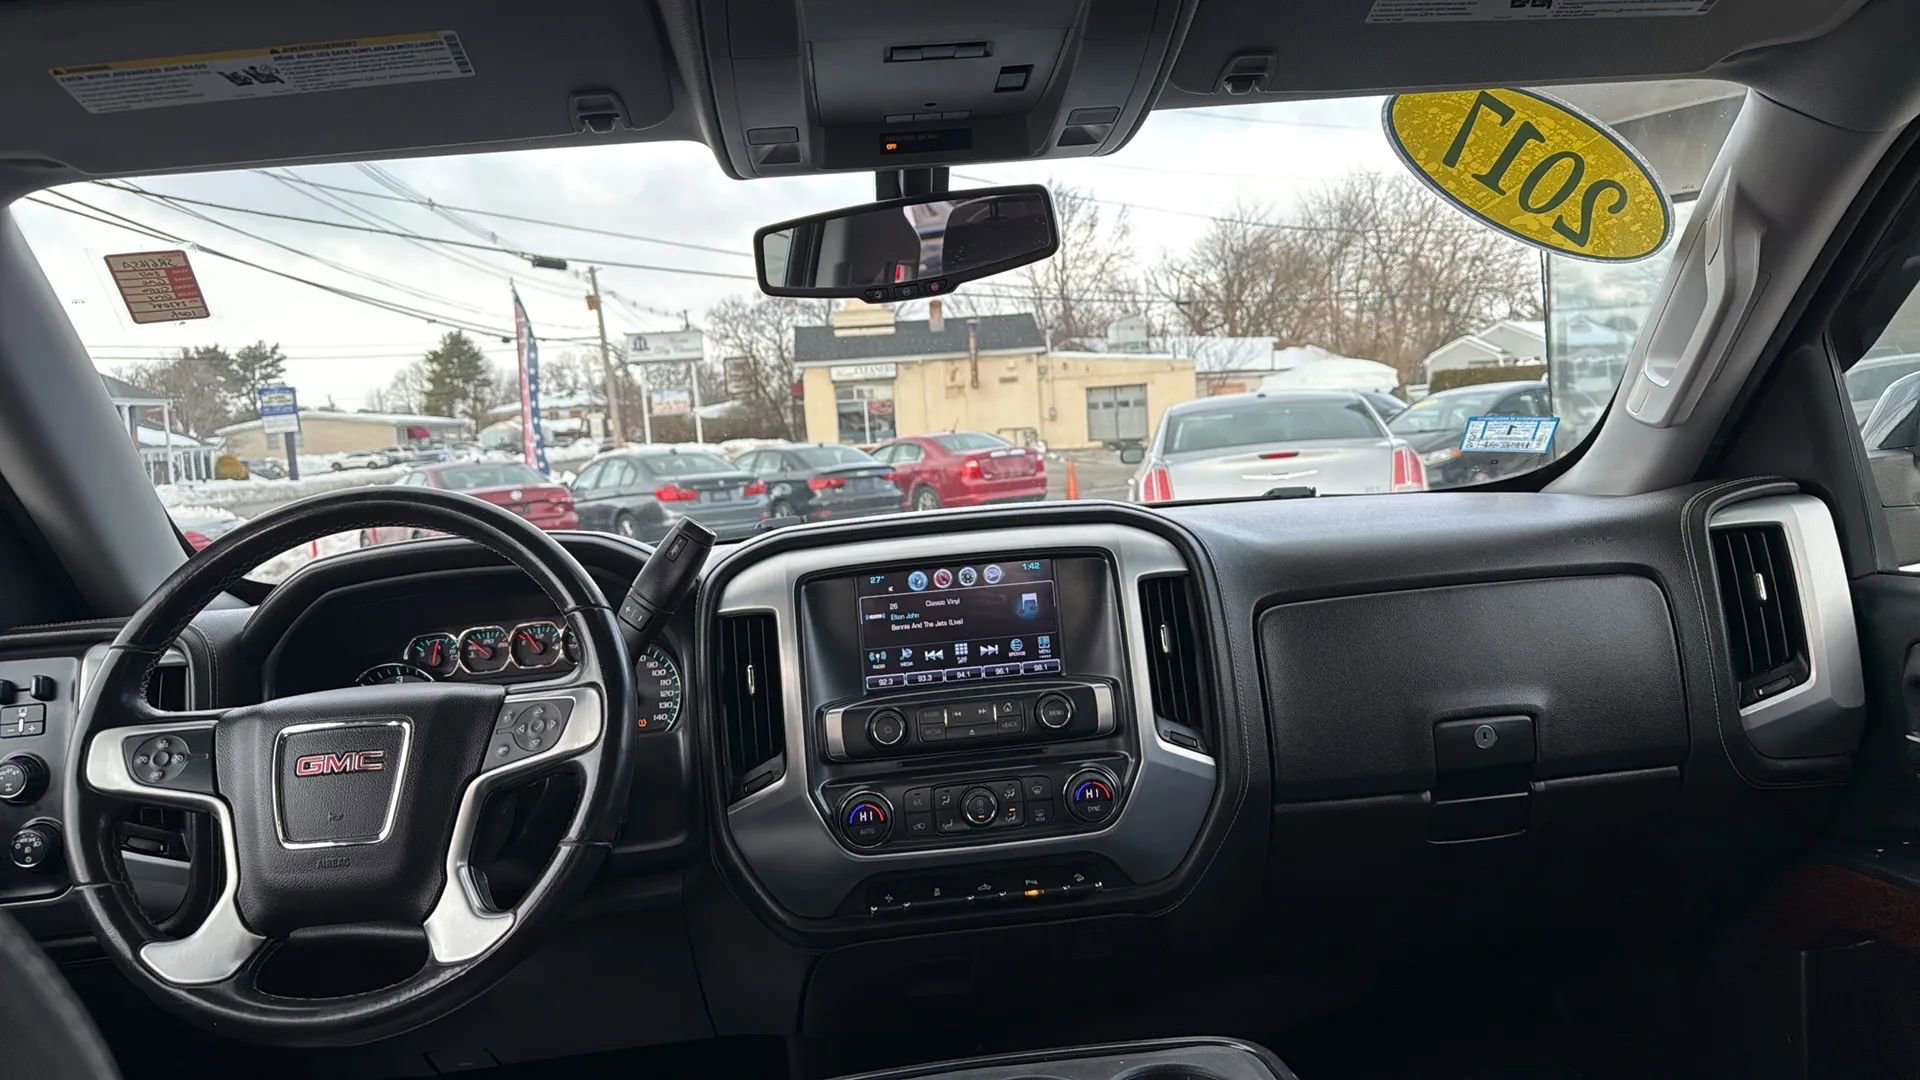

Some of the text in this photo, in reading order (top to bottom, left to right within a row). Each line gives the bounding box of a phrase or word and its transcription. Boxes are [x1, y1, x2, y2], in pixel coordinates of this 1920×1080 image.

[1022, 562, 1040, 571] 1:42
[925, 597, 960, 607] Classic Vinyl
[890, 613, 905, 621] Elton
[905, 611, 920, 619] John
[911, 621, 923, 629] And
[924, 620, 934, 628] The
[935, 619, 947, 627] Jets
[917, 674, 933, 682] 93.3
[956, 671, 971, 679] 94.1
[878, 678, 893, 686] 92.3
[659, 701, 673, 709] 130
[653, 713, 668, 721] 140
[1049, 708, 1065, 717] MENU
[296, 750, 385, 777] GMC
[1086, 788, 1100, 799] HI
[859, 812, 873, 822] HI
[860, 827, 875, 835] AUTO
[318, 857, 351, 870] AIRBAG
